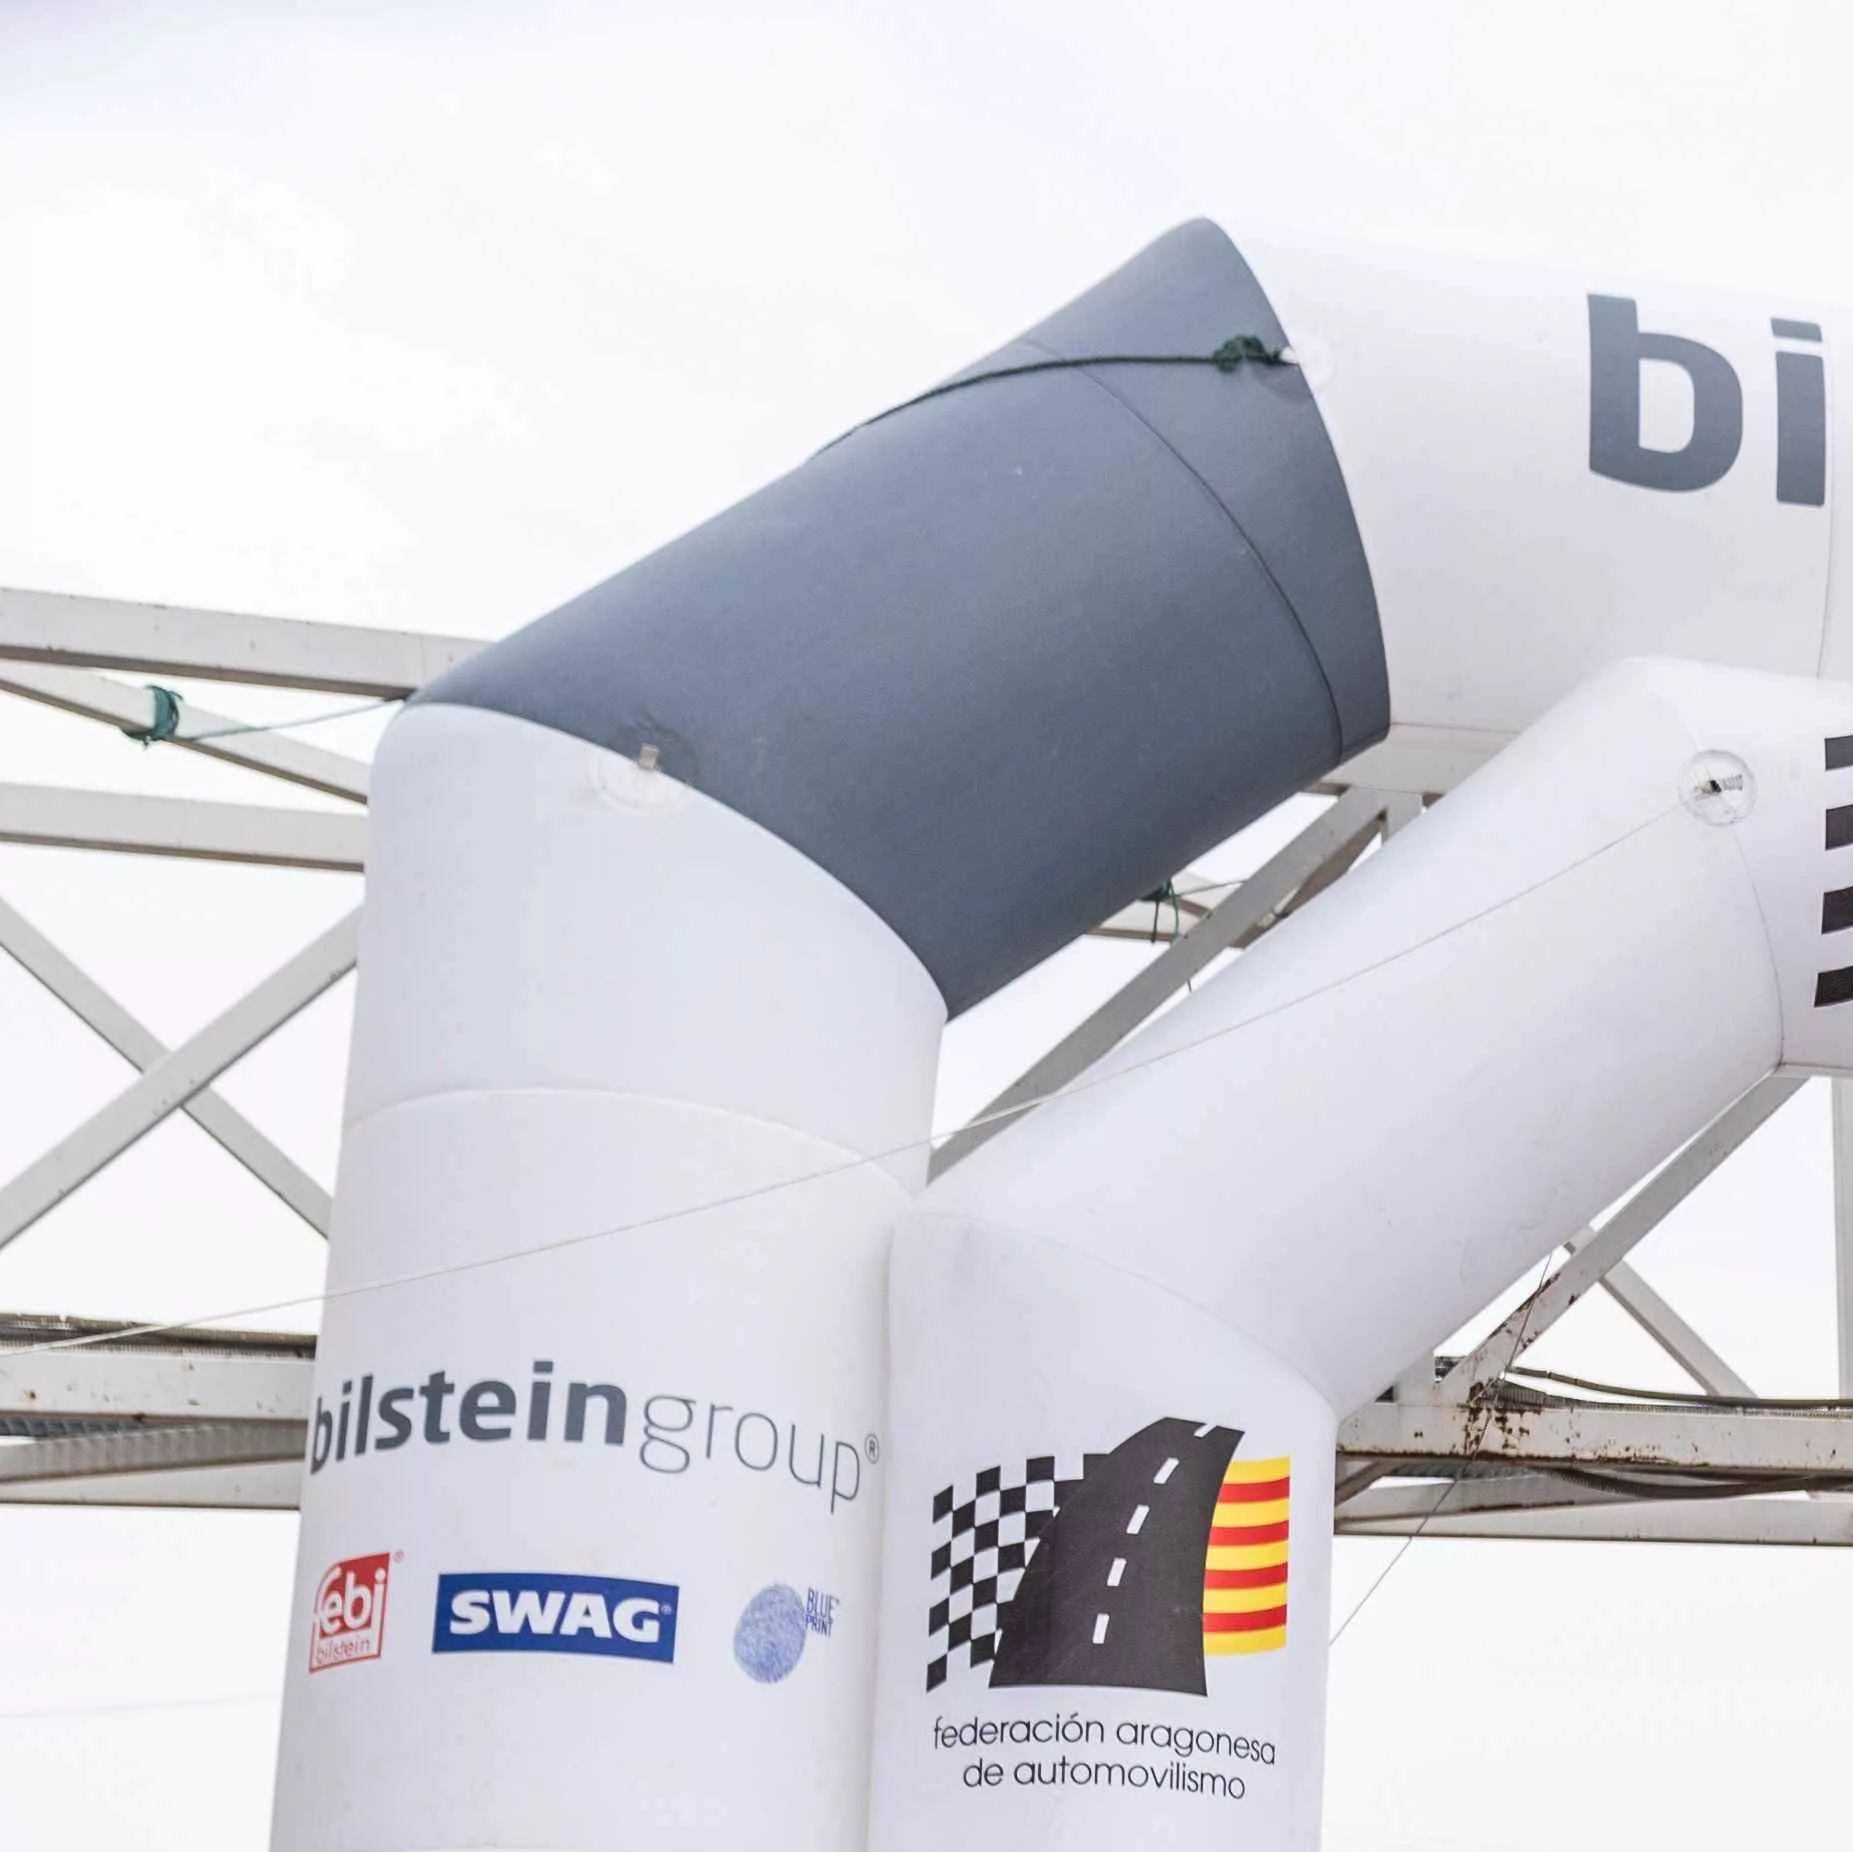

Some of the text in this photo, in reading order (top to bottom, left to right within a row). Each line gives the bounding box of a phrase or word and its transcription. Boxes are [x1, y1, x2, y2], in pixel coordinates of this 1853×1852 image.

[806, 1586, 838, 1616] BLUE
[804, 1613, 834, 1639] PRINT
[933, 1711, 1276, 1766] federación aragonesa
[962, 1755, 1247, 1800] de automovilismo
